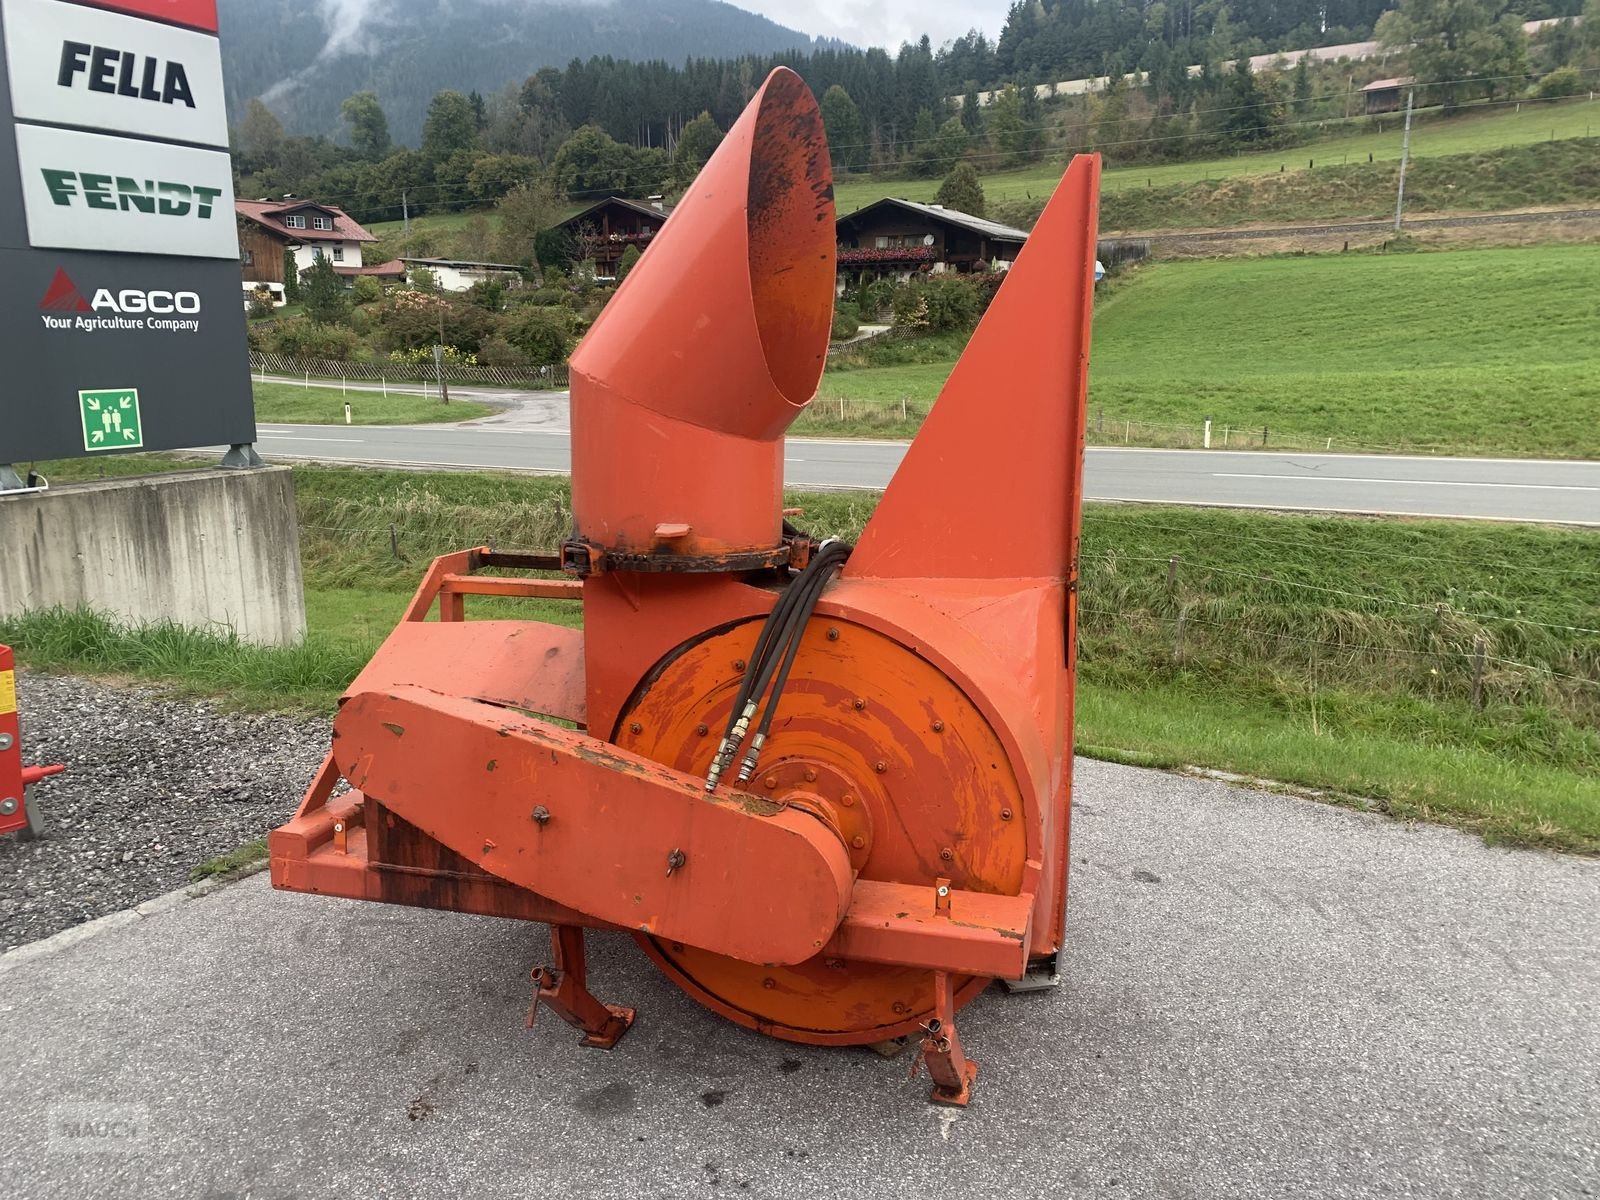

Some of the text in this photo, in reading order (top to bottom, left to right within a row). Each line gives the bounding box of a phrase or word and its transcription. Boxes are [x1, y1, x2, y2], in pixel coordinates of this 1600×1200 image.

[58, 40, 196, 109] FELLA
[40, 168, 222, 219] FENDT
[91, 288, 201, 314] AGCO
[41, 315, 199, 332] Your Agriculture Company
